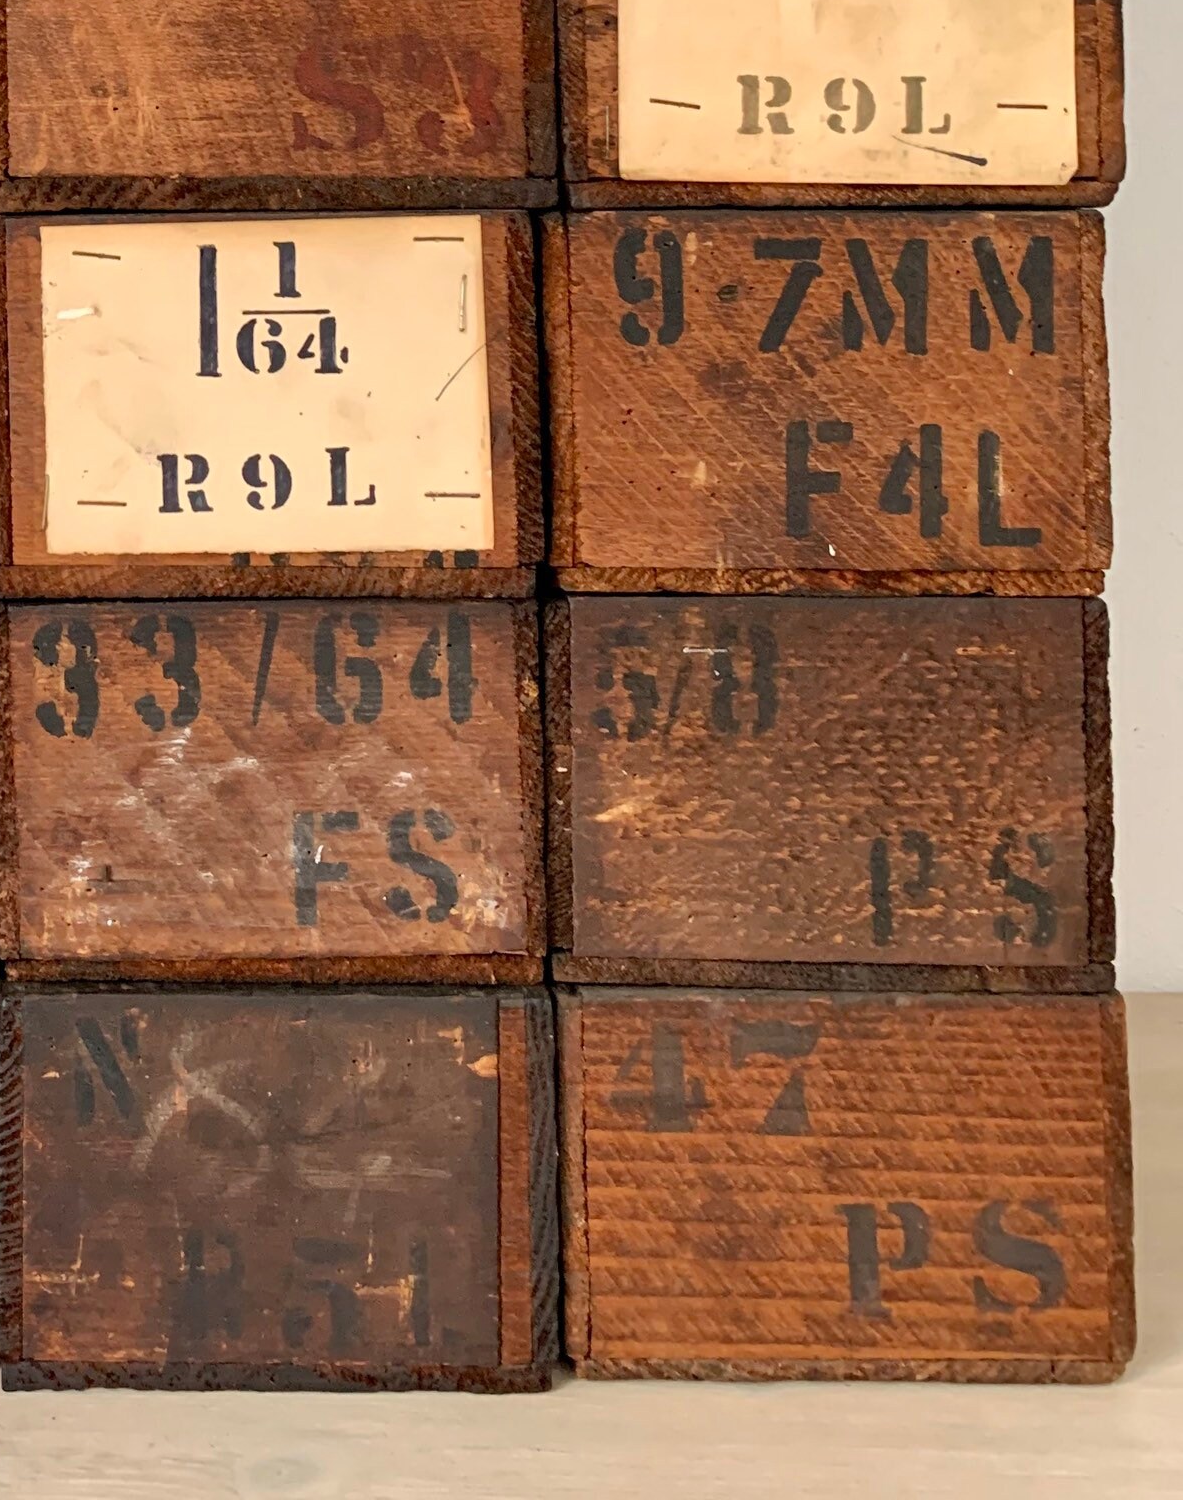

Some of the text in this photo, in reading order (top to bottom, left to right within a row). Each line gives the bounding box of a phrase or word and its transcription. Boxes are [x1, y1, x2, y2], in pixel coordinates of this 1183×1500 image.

[736, 74, 952, 136] R9L
[156, 446, 377, 514] R9L
[785, 420, 1043, 548] F4L
[32, 608, 475, 739] 33/64
[292, 807, 459, 927] FS
[869, 826, 1058, 948] PS
[609, 1018, 819, 1137] 47
[834, 1199, 1069, 1320] PS
